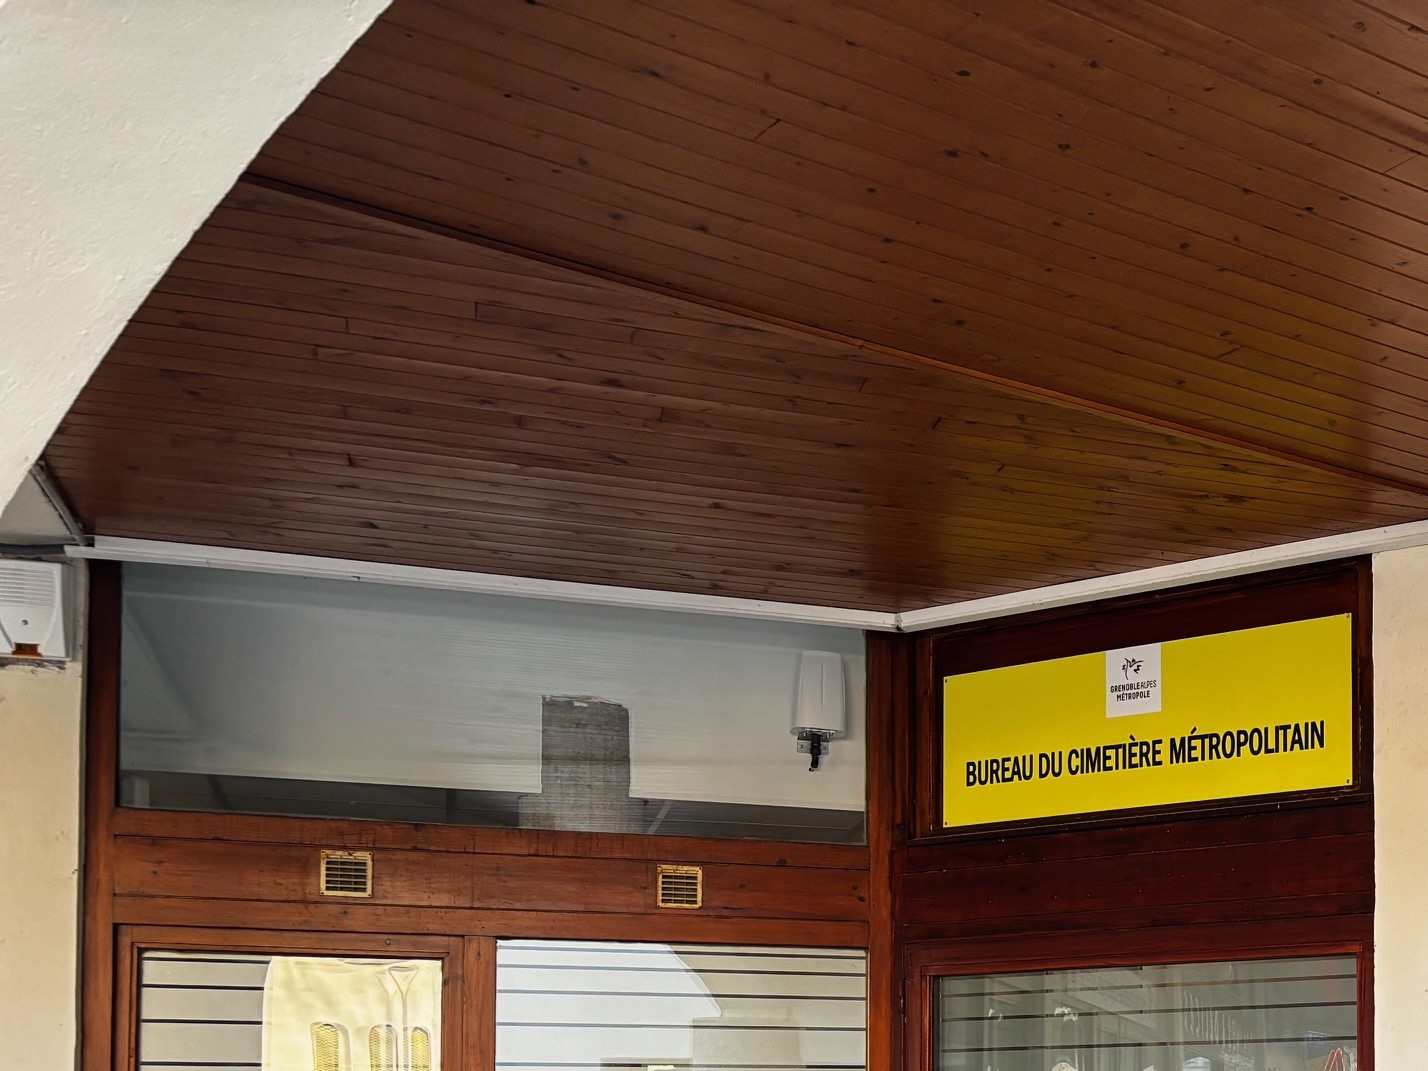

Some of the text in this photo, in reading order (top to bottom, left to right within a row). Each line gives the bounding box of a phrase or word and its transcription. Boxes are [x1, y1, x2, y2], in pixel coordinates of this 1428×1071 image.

[1116, 690, 1151, 702] MÉTROPOLE
[965, 720, 1325, 788] BUREAU DU CIMETIÈRE MÉTROPOLITAIN
